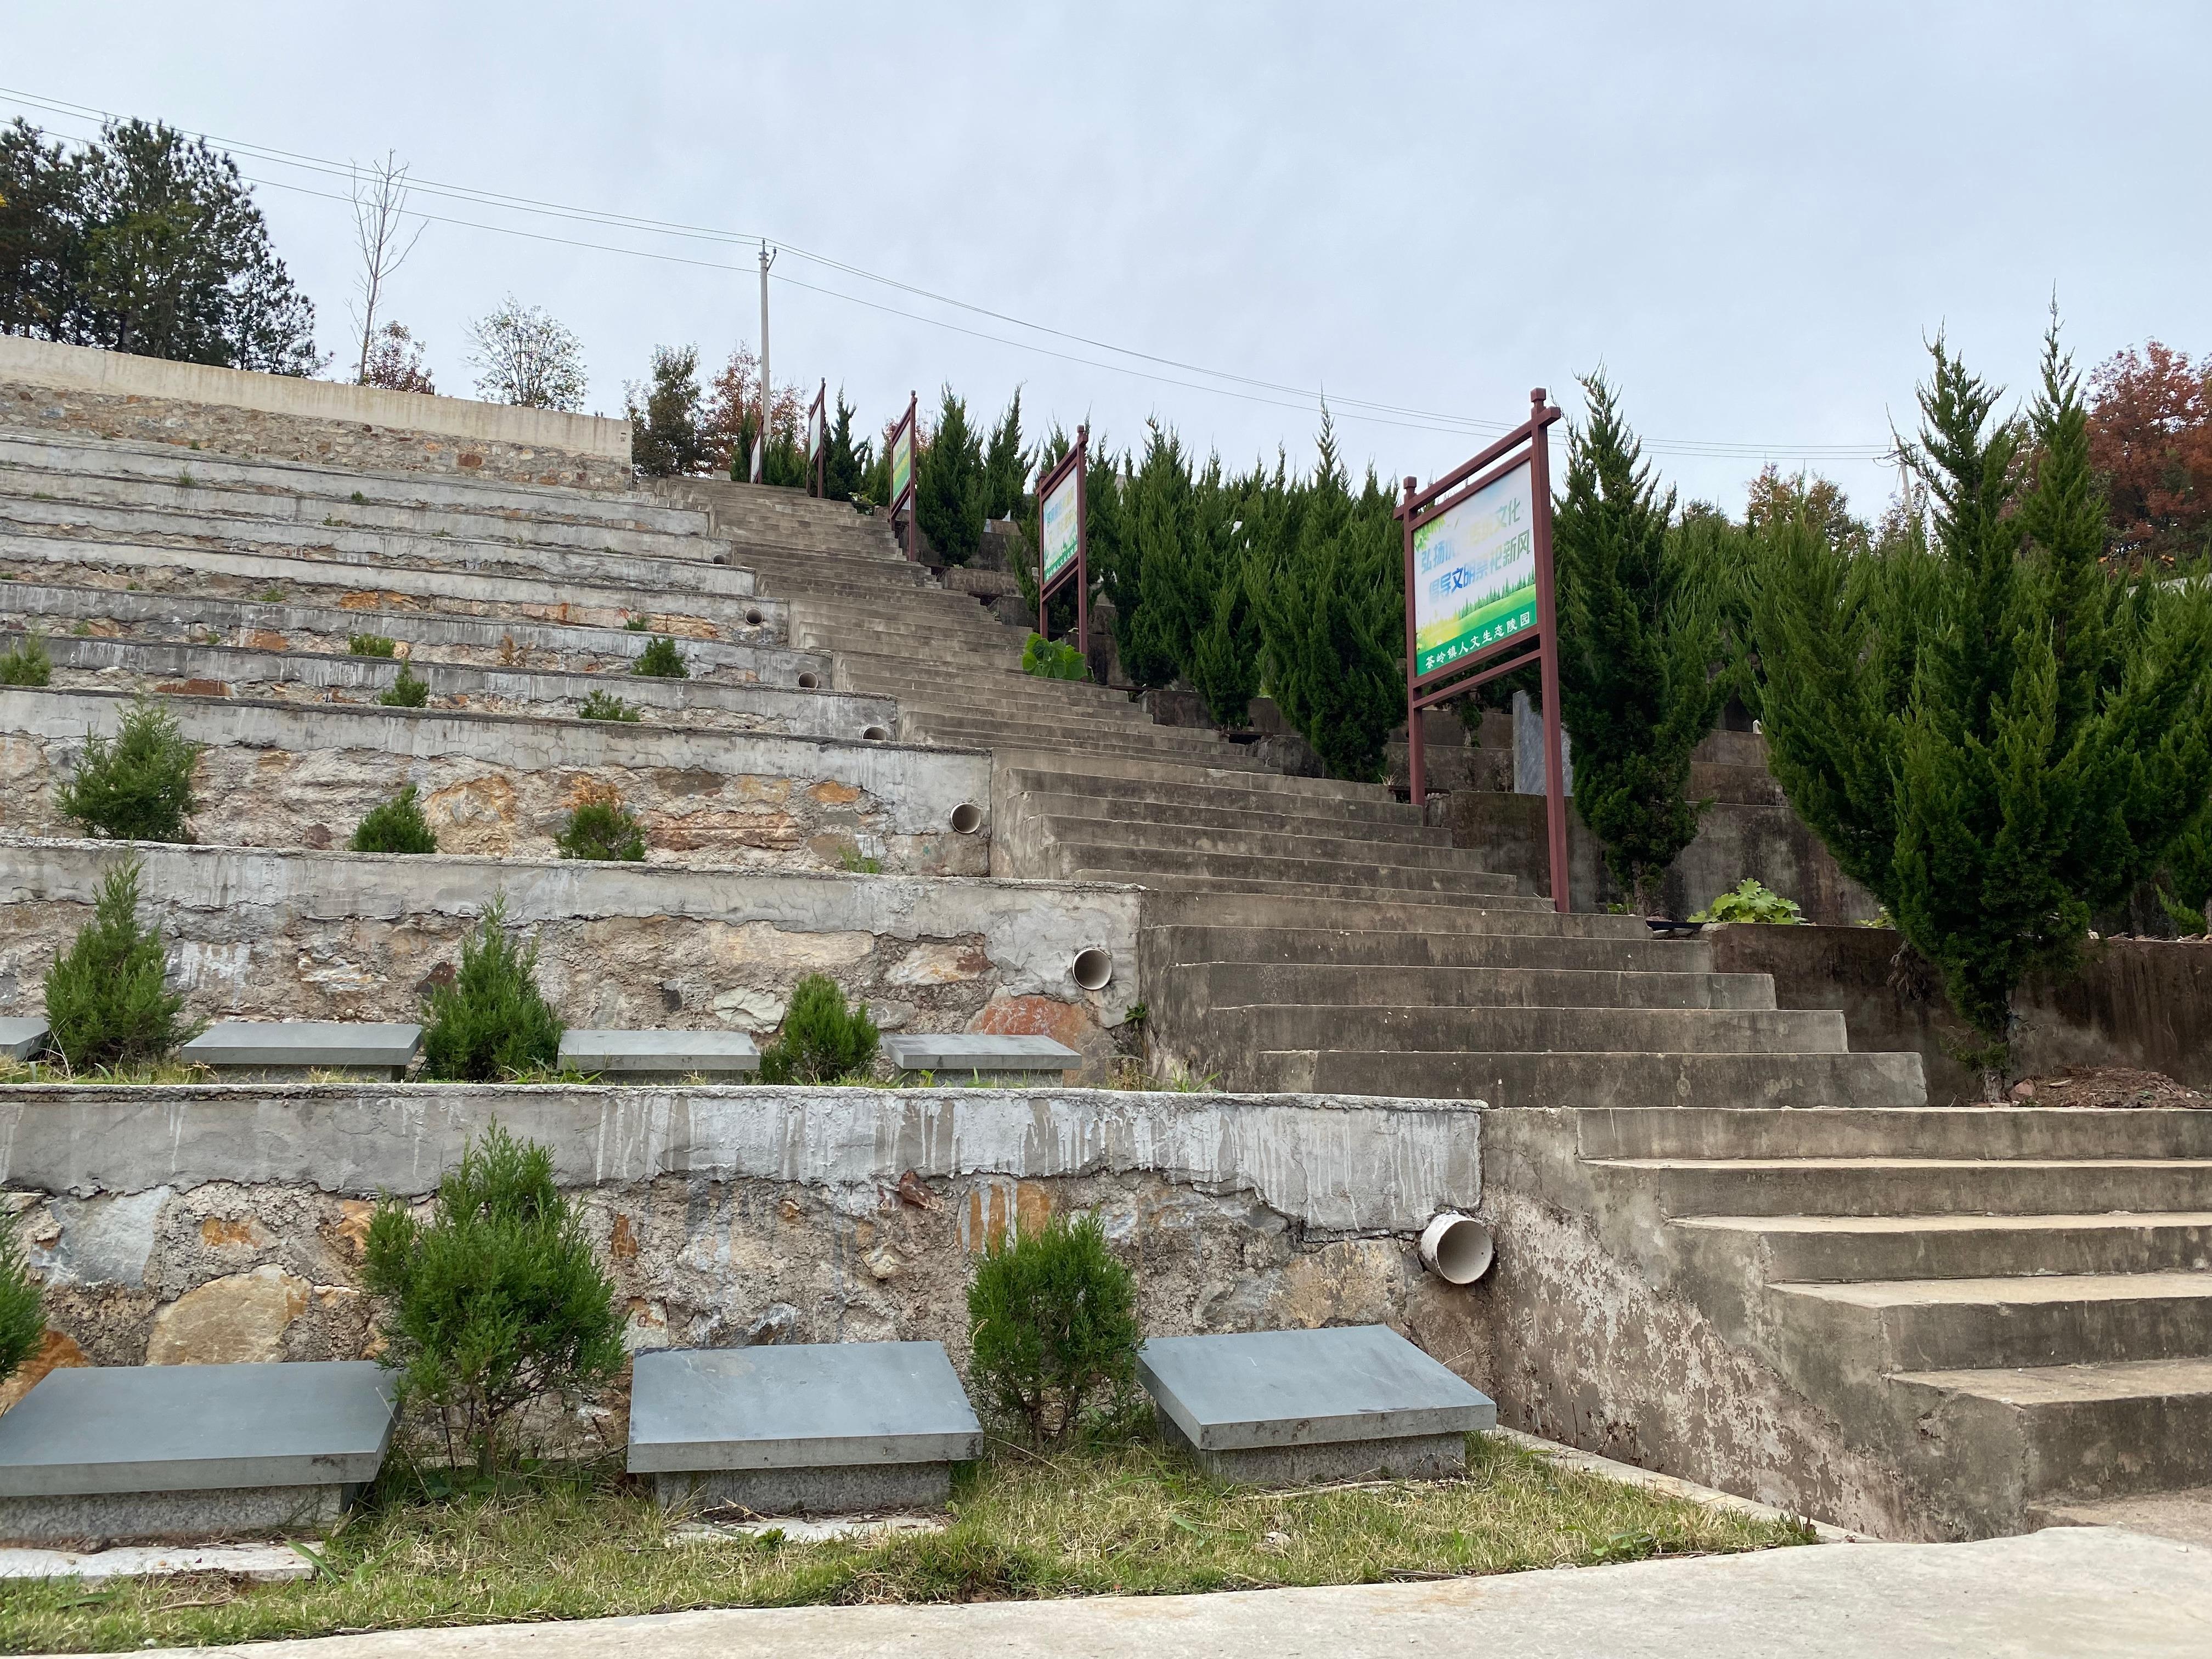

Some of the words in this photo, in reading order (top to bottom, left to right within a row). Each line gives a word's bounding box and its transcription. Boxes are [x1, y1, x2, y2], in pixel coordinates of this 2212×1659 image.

[1425, 611, 1530, 669] 茶岭镇人文生态陵园
